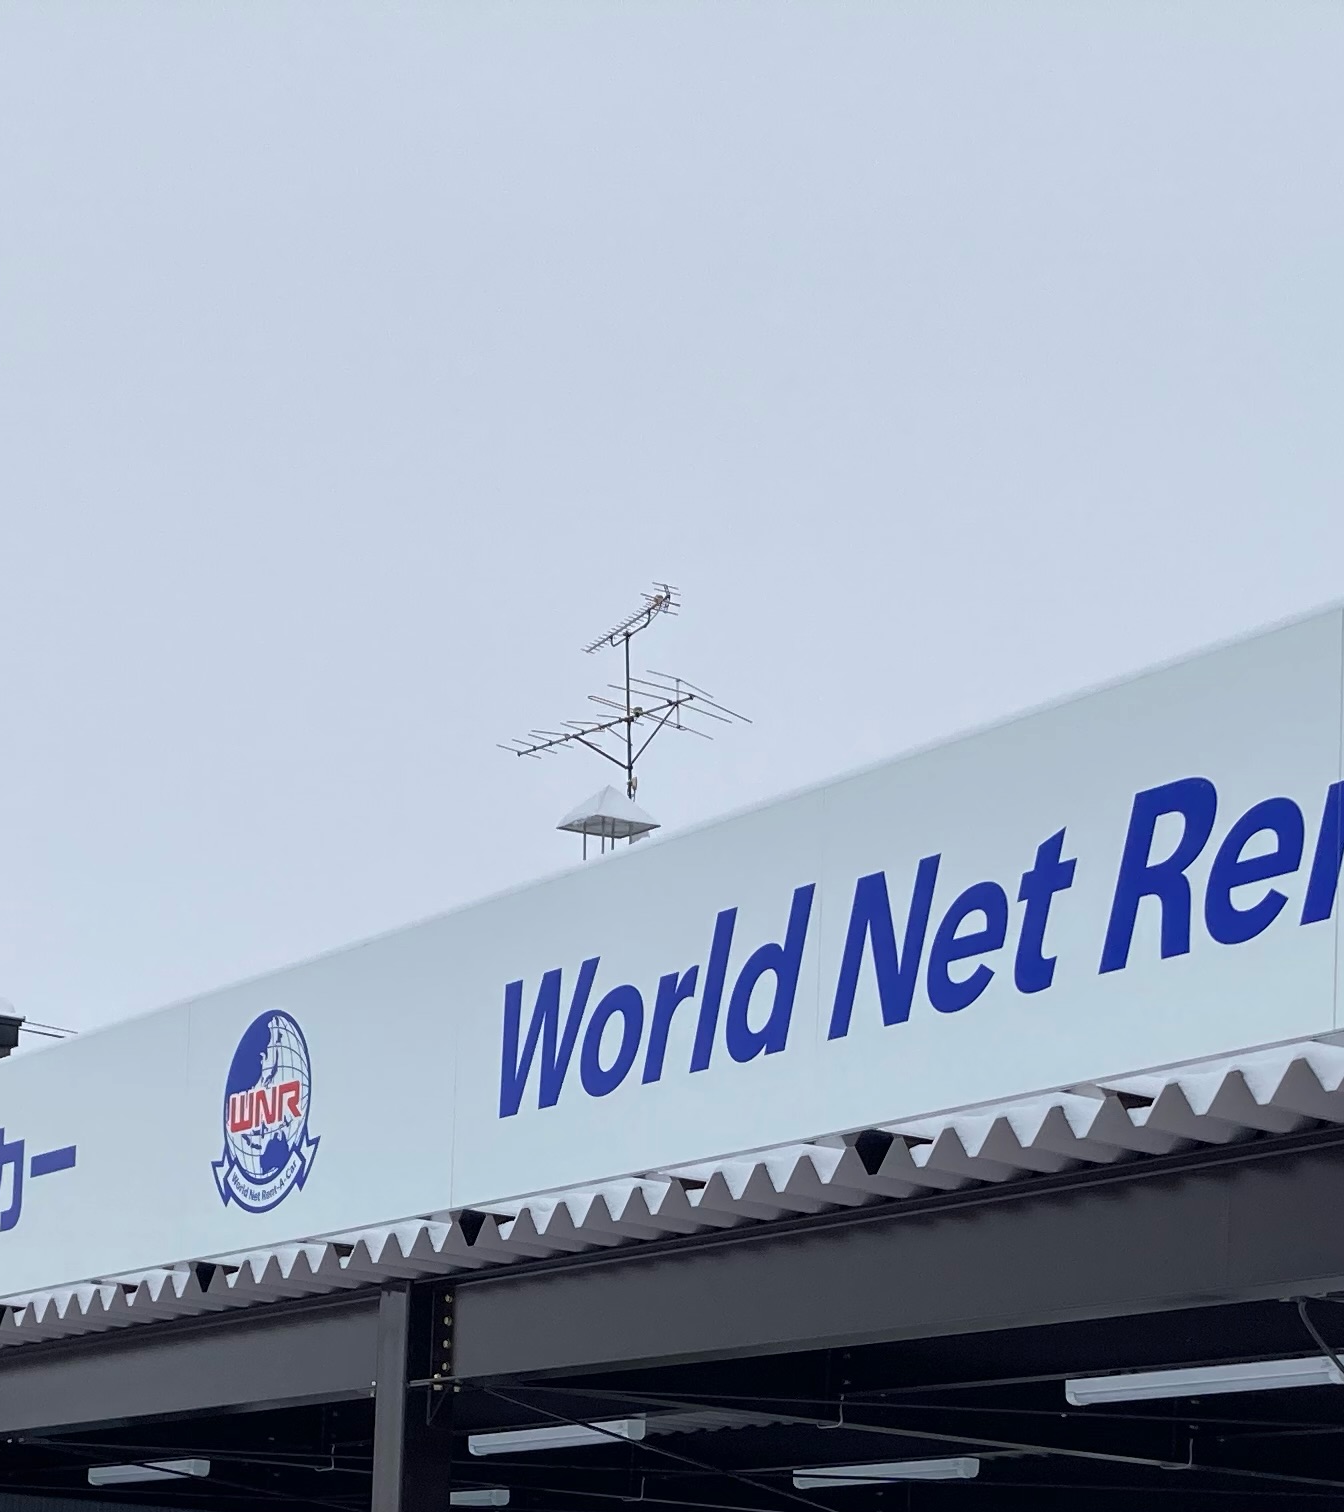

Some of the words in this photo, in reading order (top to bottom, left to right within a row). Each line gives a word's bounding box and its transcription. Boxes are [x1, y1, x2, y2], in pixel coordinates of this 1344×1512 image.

[499, 883, 815, 1118] World
[828, 826, 1077, 1041] Net
[230, 1080, 301, 1133] WNR
[232, 1171, 249, 1198] World
[249, 1188, 261, 1202] Net
[261, 1160, 297, 1201] Rent-A-Car
